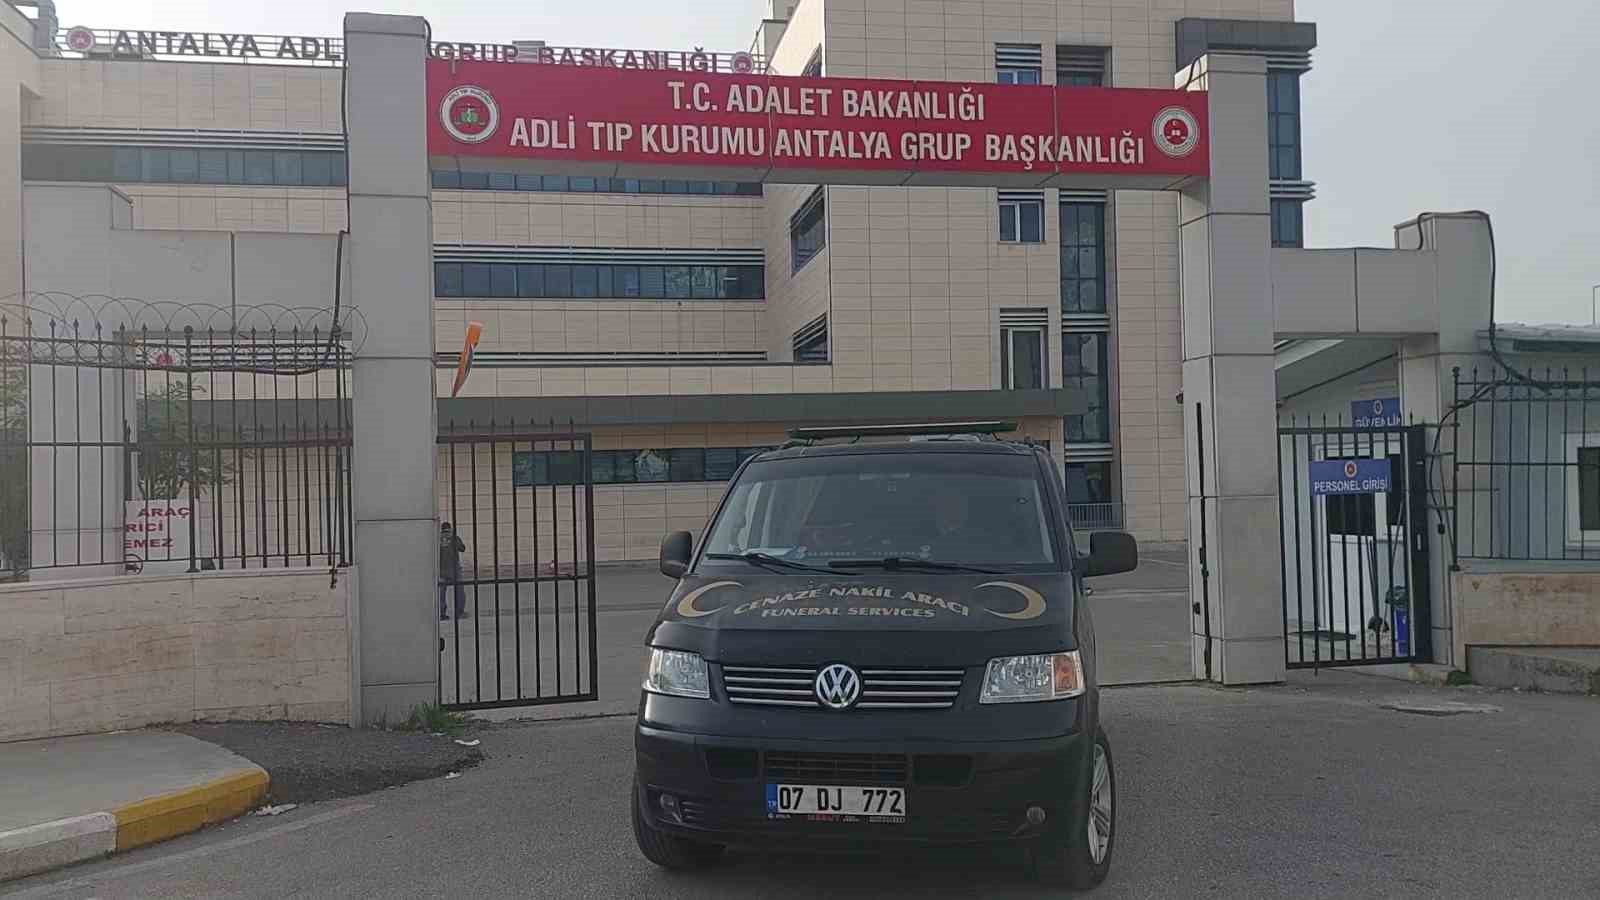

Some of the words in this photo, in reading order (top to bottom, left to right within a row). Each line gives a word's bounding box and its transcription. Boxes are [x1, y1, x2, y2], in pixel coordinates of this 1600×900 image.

[112, 30, 261, 57] ANTALYA
[276, 36, 341, 60] ADL
[435, 42, 519, 63] GRUP
[667, 80, 718, 111] T.C.
[726, 84, 833, 117] ADALET
[842, 86, 985, 121] BAKANLIĞI
[509, 115, 576, 150] ADLİ
[586, 121, 633, 152] TIP
[641, 123, 765, 157] KURUMU
[774, 128, 892, 160] ANTALYA
[900, 132, 972, 161] GRUP
[985, 130, 1144, 170] BAŞKANLIĞI
[1314, 479, 1361, 493] PERSONEL
[138, 507, 190, 520] ARAÇ
[123, 538, 175, 549] EMEZ
[733, 588, 821, 615] CENAZE
[900, 591, 969, 617] ARACI
[761, 607, 841, 617] FUNERAL
[847, 607, 936, 618] SERVICES
[779, 786, 804, 810] 07
[817, 788, 842, 811] DJ
[862, 789, 903, 814] 772
